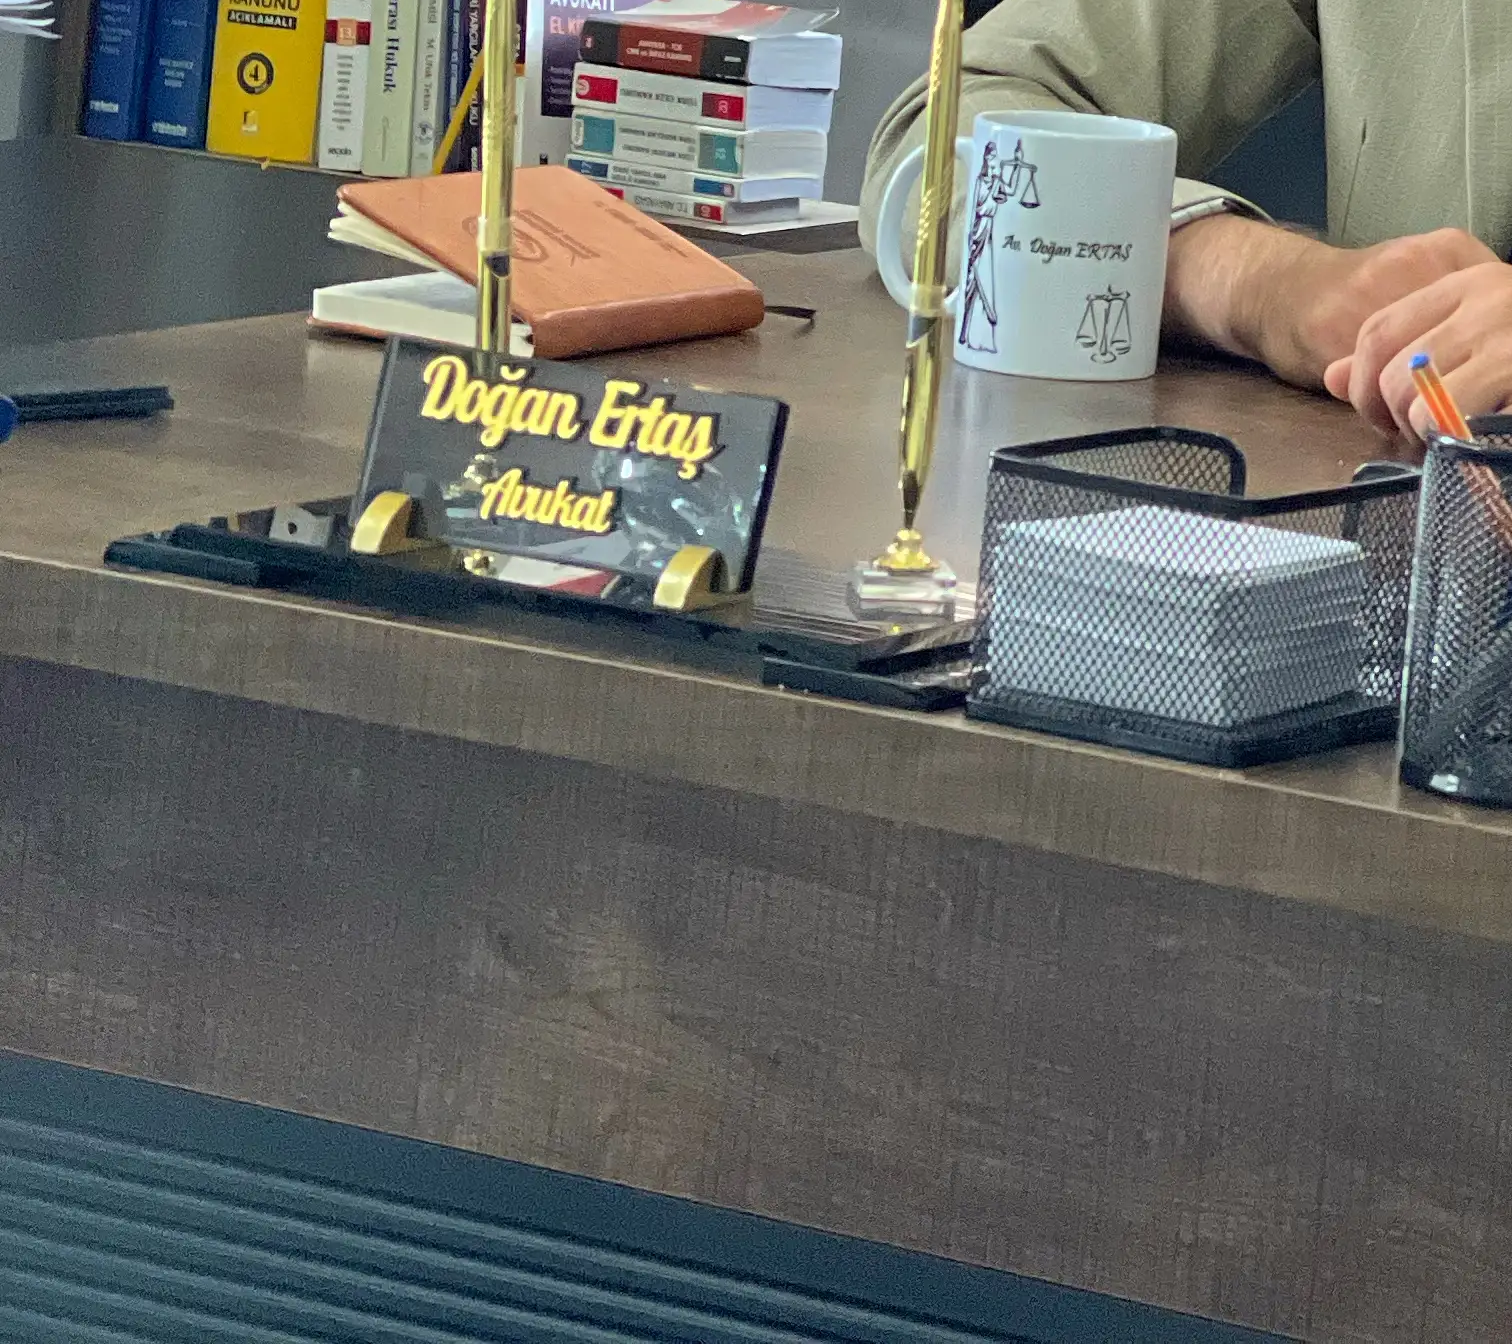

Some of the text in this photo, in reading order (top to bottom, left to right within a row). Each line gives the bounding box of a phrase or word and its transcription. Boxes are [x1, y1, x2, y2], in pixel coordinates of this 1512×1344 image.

[382, 37, 401, 94] Hukuk
[1030, 237, 1071, 263] Doğan
[421, 353, 723, 480] Doğan Ertaş
[480, 467, 616, 533] Avukat
